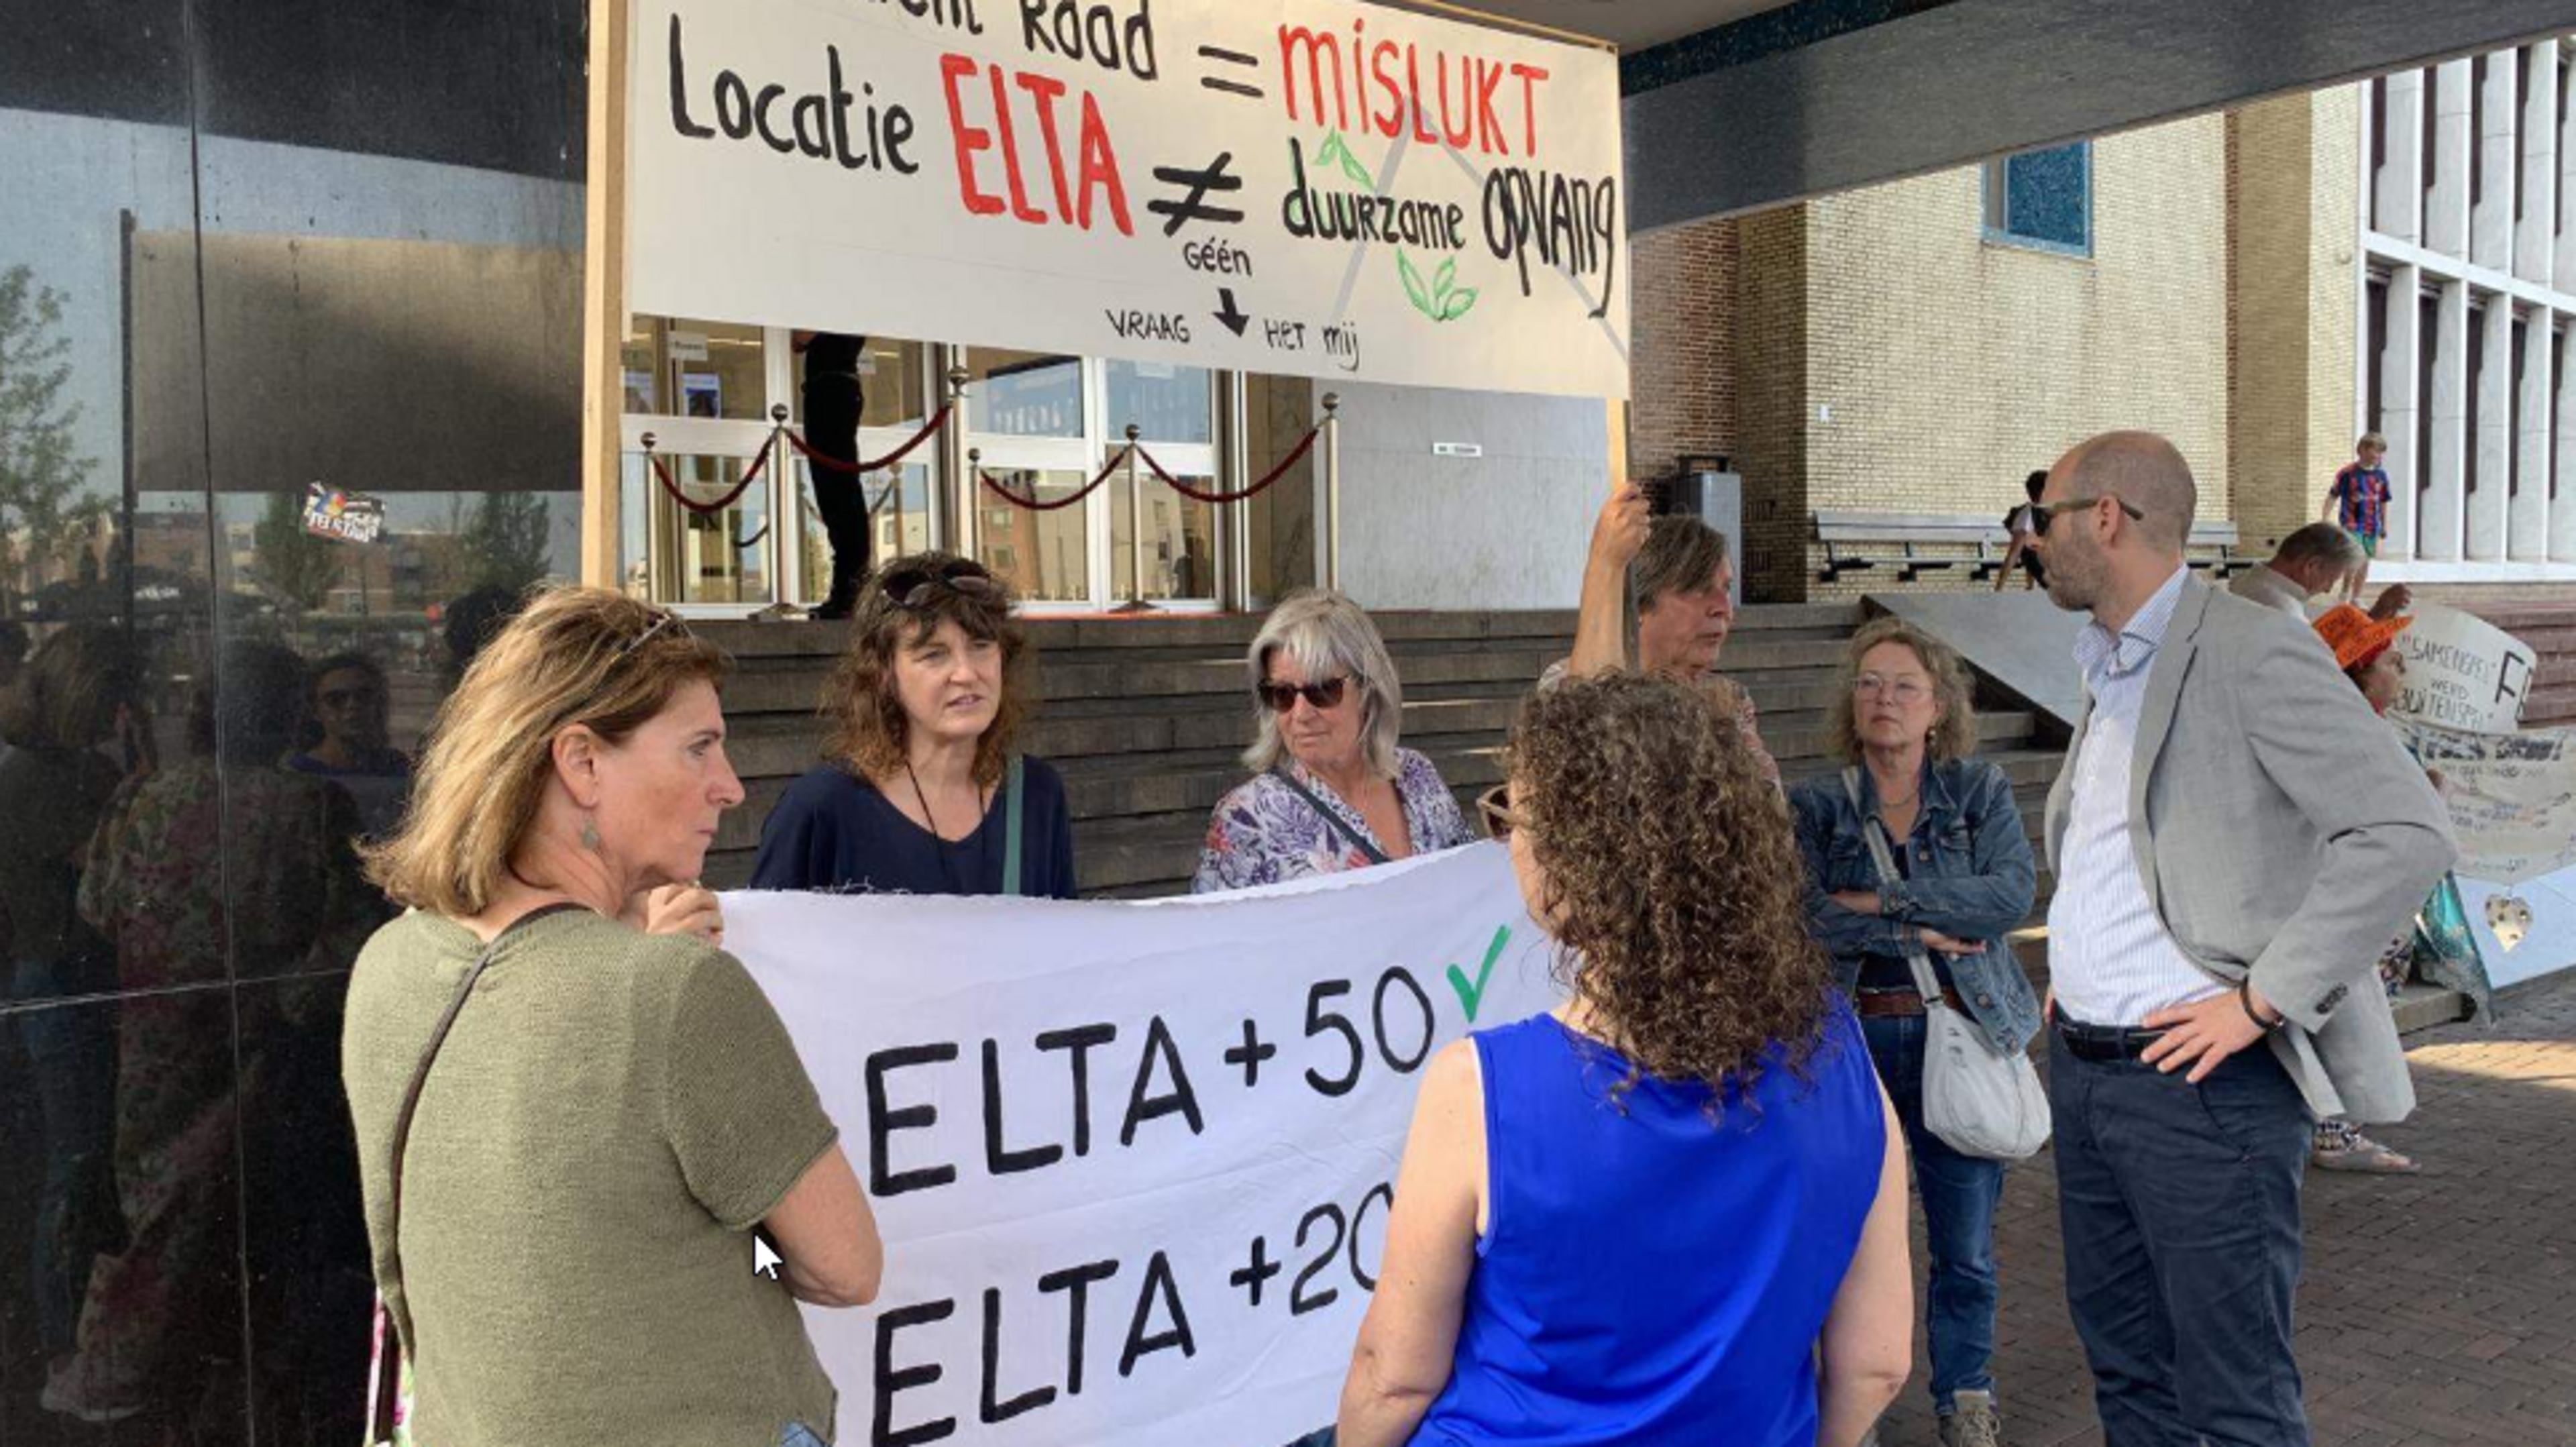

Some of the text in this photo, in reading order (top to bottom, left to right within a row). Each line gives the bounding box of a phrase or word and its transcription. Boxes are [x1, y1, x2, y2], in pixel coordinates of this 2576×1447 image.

[670, 13, 918, 174] Locatie
[939, 53, 1134, 236] ELTA
[1106, 309, 1191, 343] VRAAG
[865, 1016, 1204, 1197] ELTA
[871, 1251, 1196, 1447] ELTA
